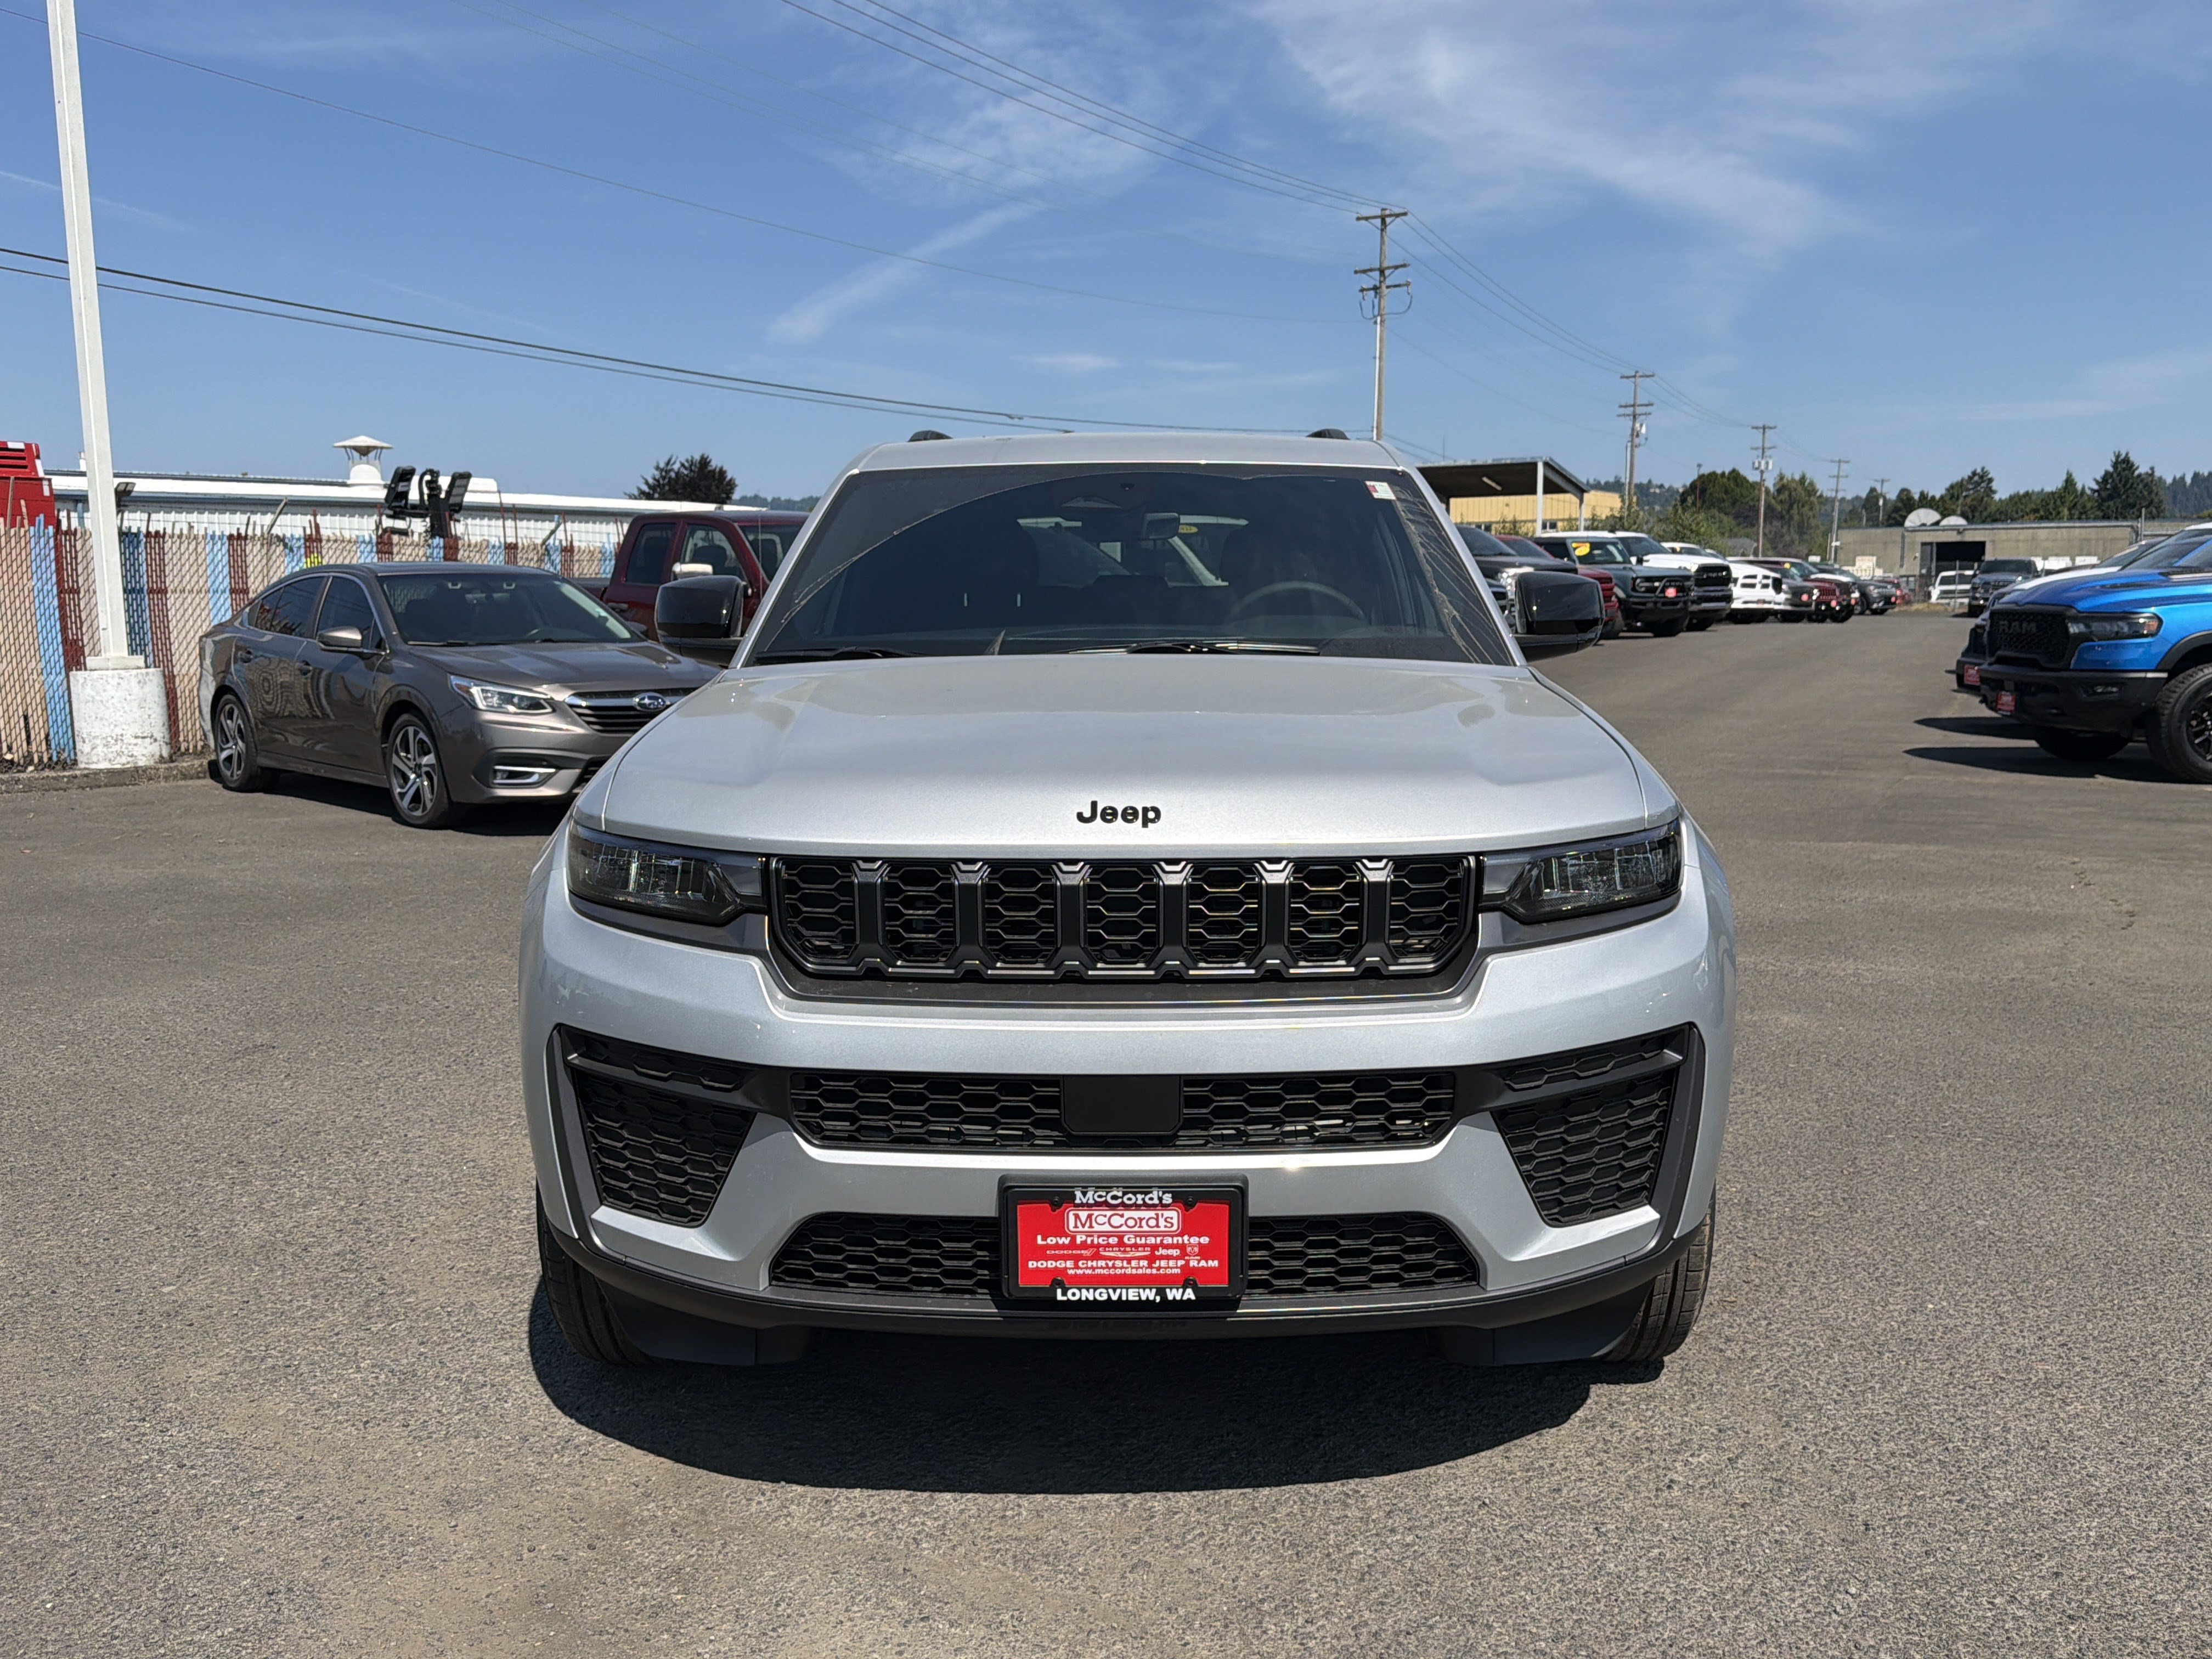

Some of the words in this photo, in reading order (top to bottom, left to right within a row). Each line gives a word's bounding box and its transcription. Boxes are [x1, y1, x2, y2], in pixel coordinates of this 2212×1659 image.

[1999, 621, 2036, 634] RAM
[1076, 800, 1161, 828] Jeep
[1074, 1190, 1172, 1204] McCord's
[1073, 1213, 1173, 1229] McCord's
[1037, 1235, 1070, 1244] Low
[1076, 1235, 1118, 1244] Price
[1123, 1234, 1210, 1244] Guarantee
[1155, 1246, 1181, 1256] Jeep
[1078, 1260, 1148, 1268] CHRYSLER
[1057, 1288, 1160, 1302] LONGVIEW,
[1166, 1288, 1196, 1300] WA
